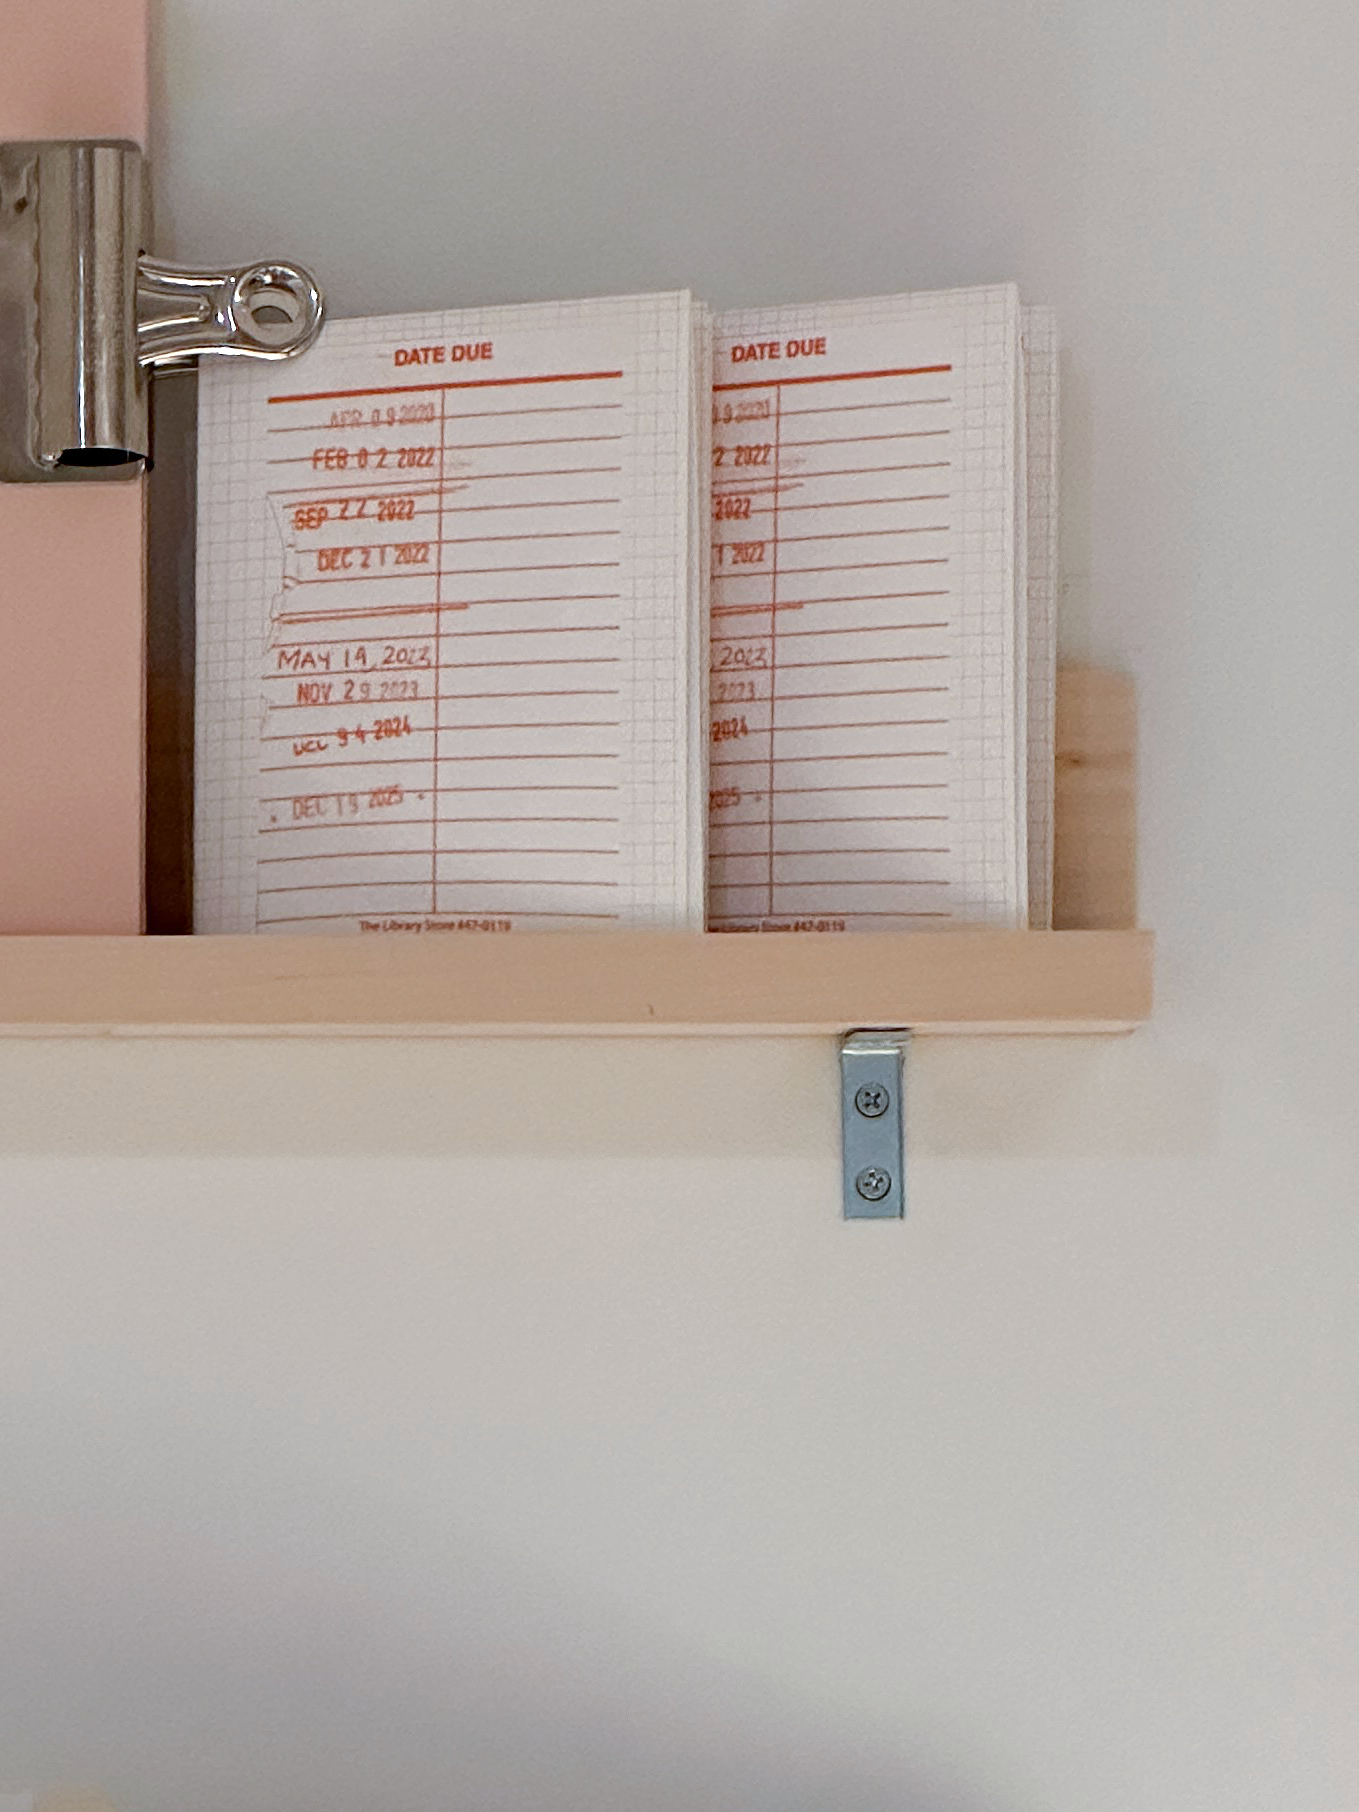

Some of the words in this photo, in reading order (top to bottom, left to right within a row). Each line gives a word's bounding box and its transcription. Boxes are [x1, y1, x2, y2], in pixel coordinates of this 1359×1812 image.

[394, 346, 445, 366] DATE
[451, 342, 493, 362] DUE
[731, 342, 780, 363] DATE
[786, 336, 826, 358] DUE
[312, 448, 348, 470] FEB
[397, 446, 435, 469] 2022
[735, 444, 771, 467] 2022
[294, 506, 329, 532] SEP
[377, 499, 415, 522] 2022
[317, 548, 353, 572] DEC
[394, 543, 430, 565] 2022
[277, 648, 332, 671] MAY
[297, 682, 332, 706] NOV
[373, 715, 412, 740] 2024
[359, 919, 380, 932] The
[382, 919, 422, 934] Library
[425, 919, 455, 932] Store
